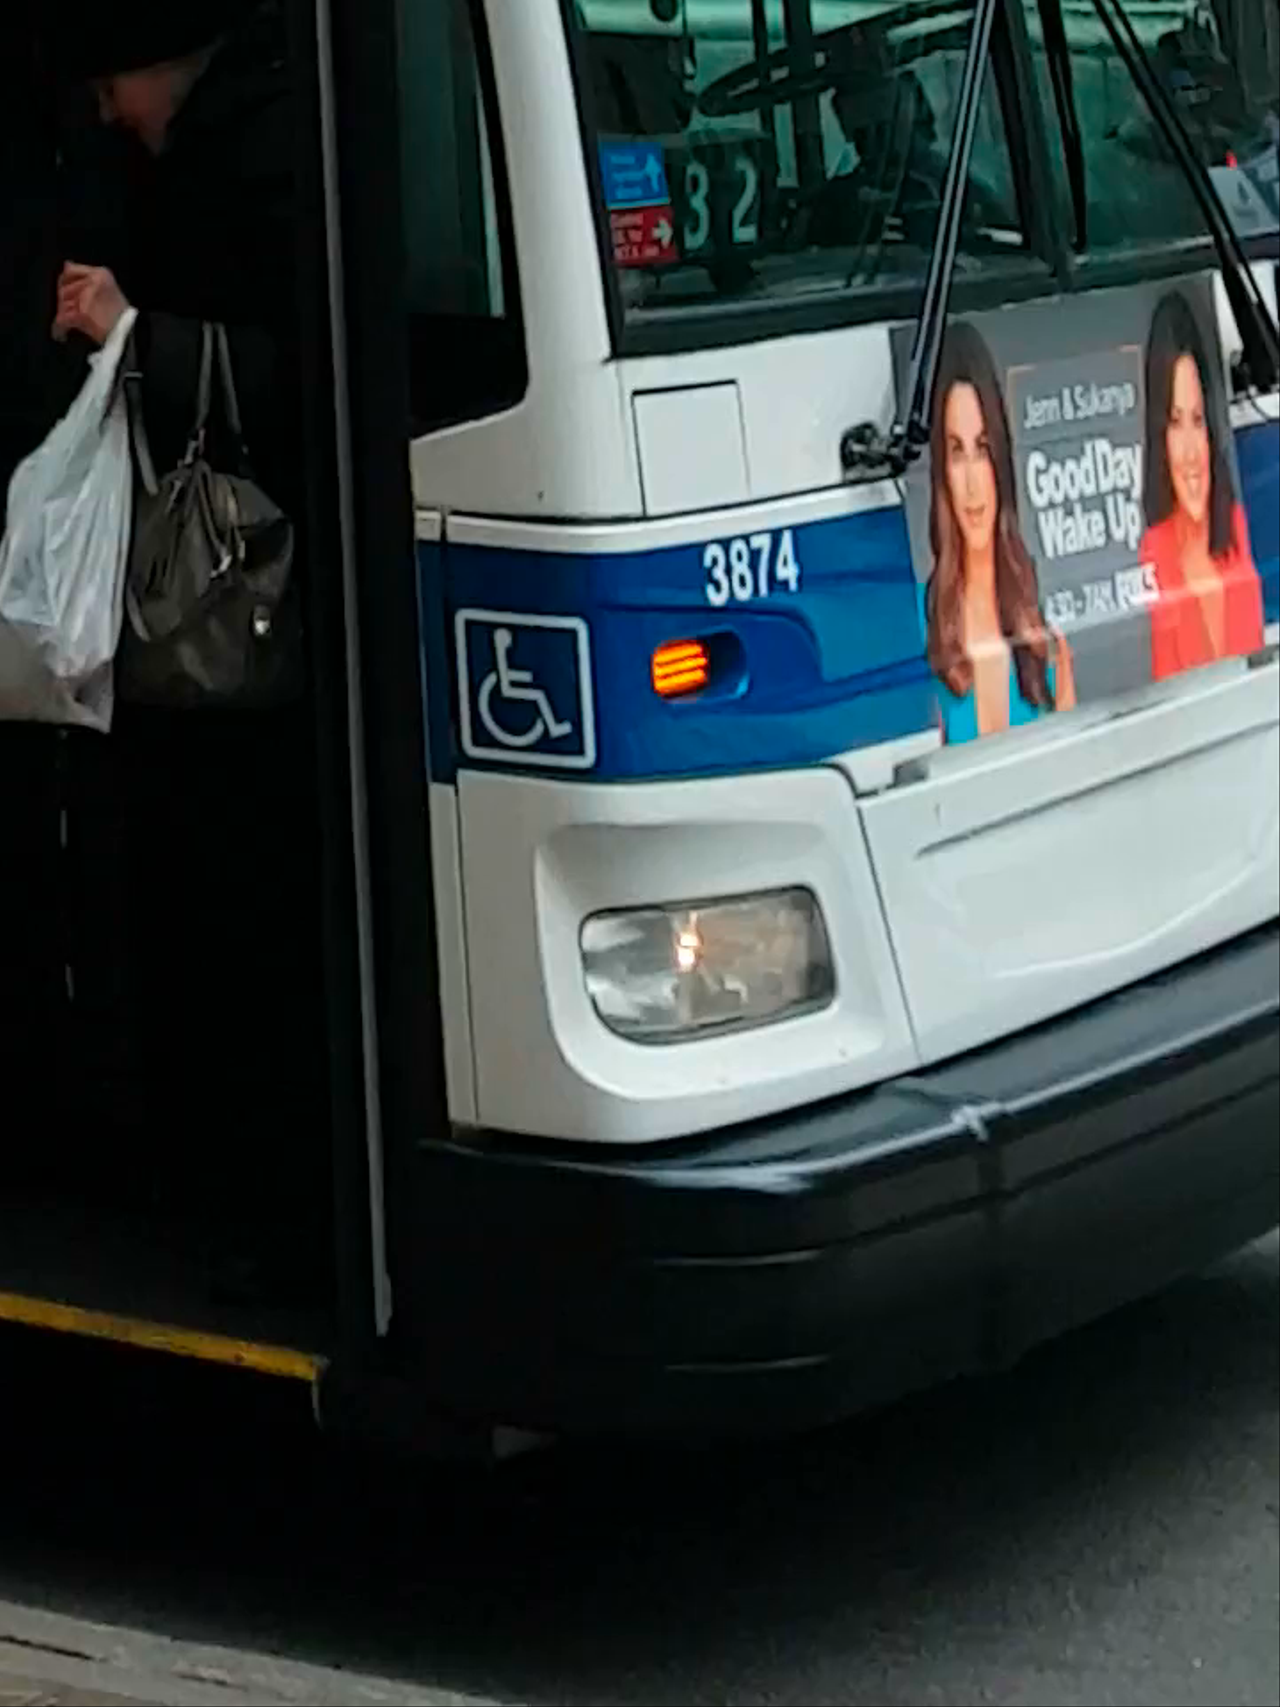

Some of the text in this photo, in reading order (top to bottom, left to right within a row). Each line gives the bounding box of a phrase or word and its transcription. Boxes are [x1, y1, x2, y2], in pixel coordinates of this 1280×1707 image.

[1026, 437, 1143, 508] Good Day
[1038, 492, 1141, 560] Wake Up
[703, 529, 801, 606] 3874
